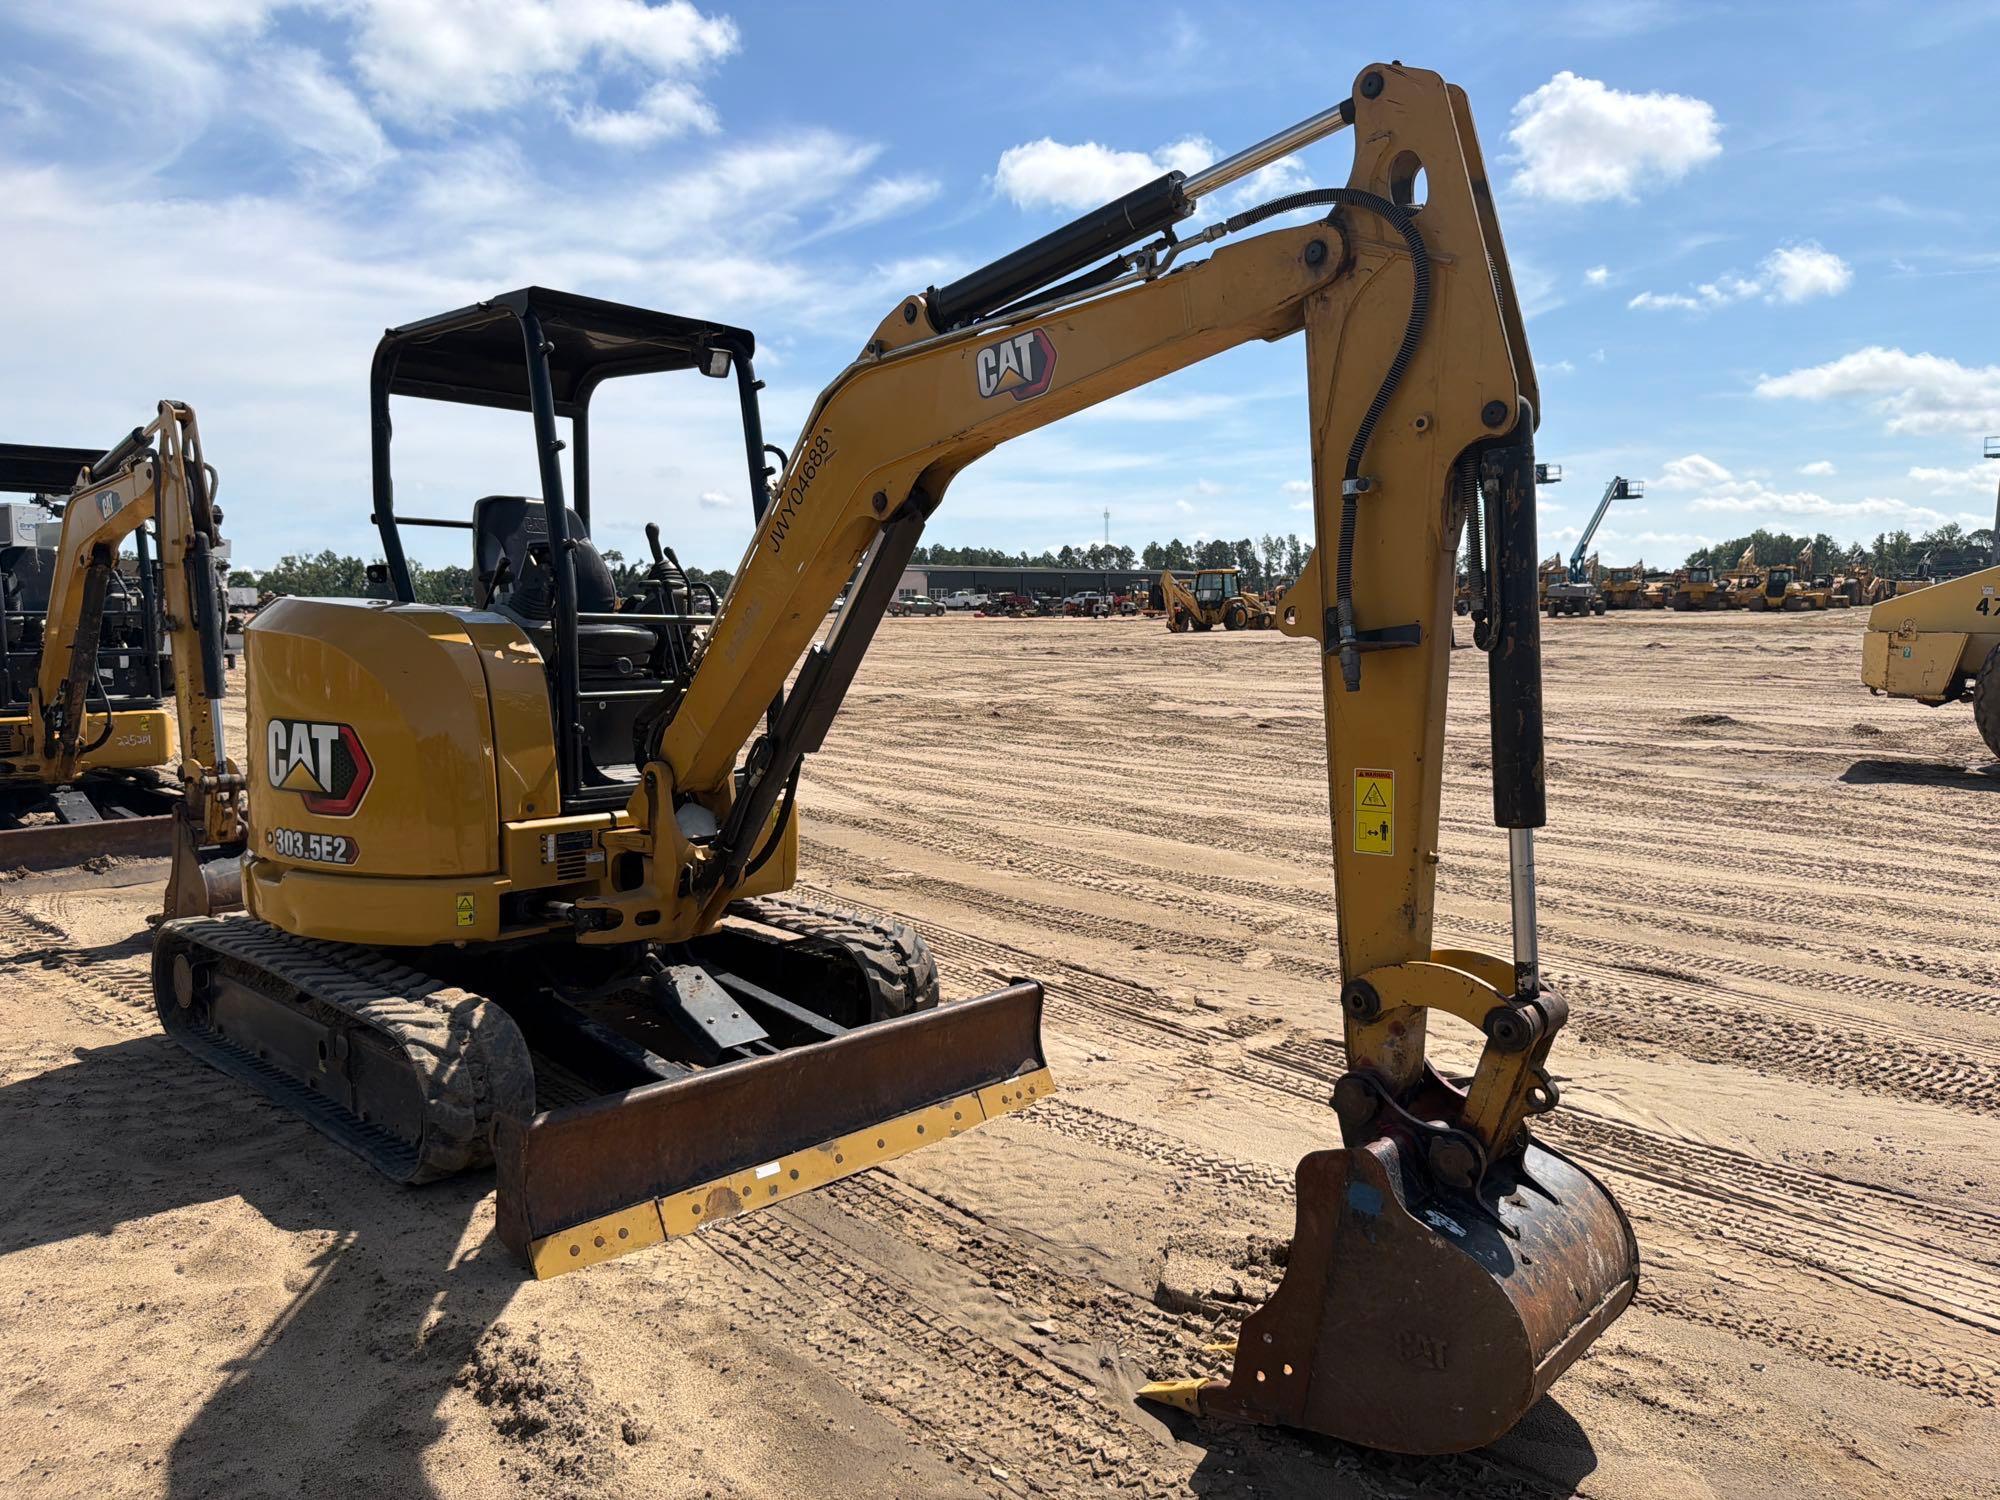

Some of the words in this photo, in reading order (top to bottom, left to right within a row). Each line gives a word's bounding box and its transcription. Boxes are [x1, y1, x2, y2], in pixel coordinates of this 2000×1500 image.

[977, 332, 1034, 397] CAT
[102, 492, 114, 519] CAT
[770, 435, 829, 553] JWY04688
[268, 719, 339, 793] CAT
[275, 828, 347, 863] 303.5E2
